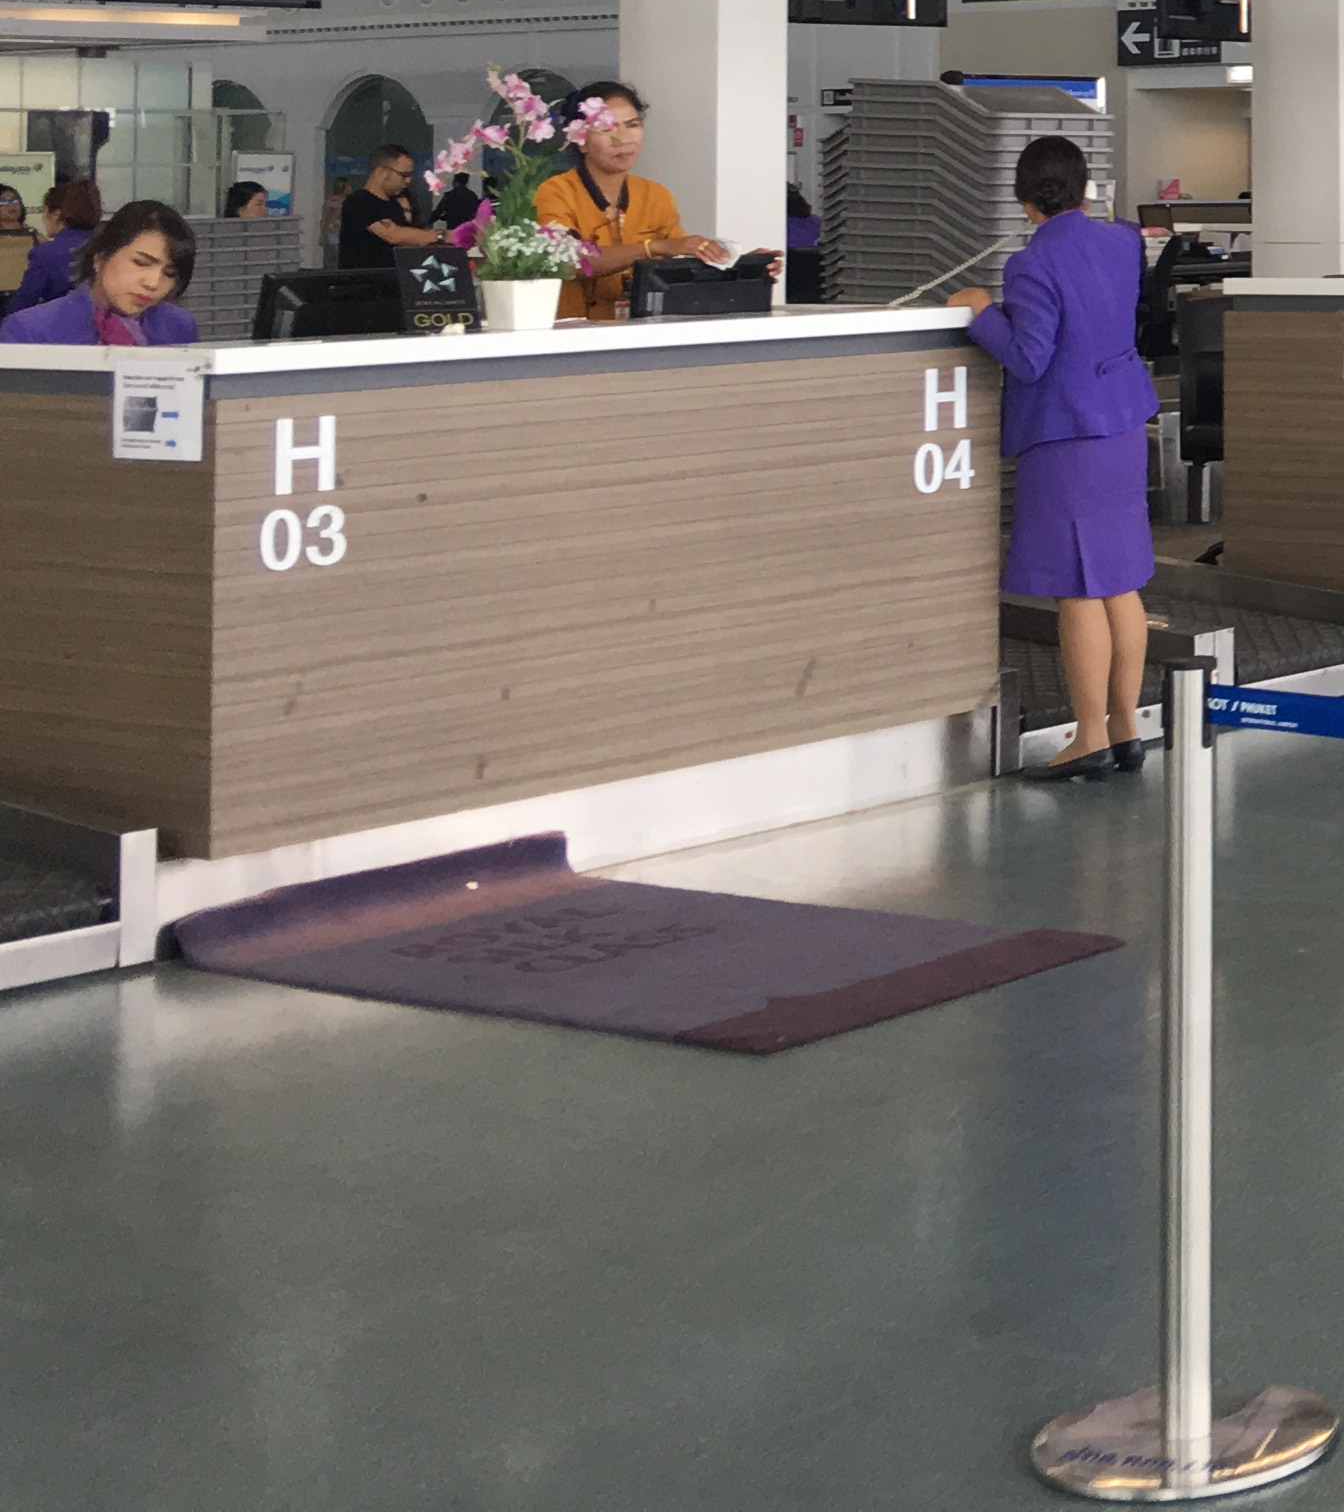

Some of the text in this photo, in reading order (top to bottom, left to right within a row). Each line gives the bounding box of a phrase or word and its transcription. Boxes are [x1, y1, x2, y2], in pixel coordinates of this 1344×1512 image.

[413, 313, 474, 327] GOLD
[923, 367, 968, 432] H
[275, 416, 336, 495] H
[913, 439, 975, 494] 04
[259, 505, 347, 571] 03
[1240, 702, 1277, 716] PHUKET
